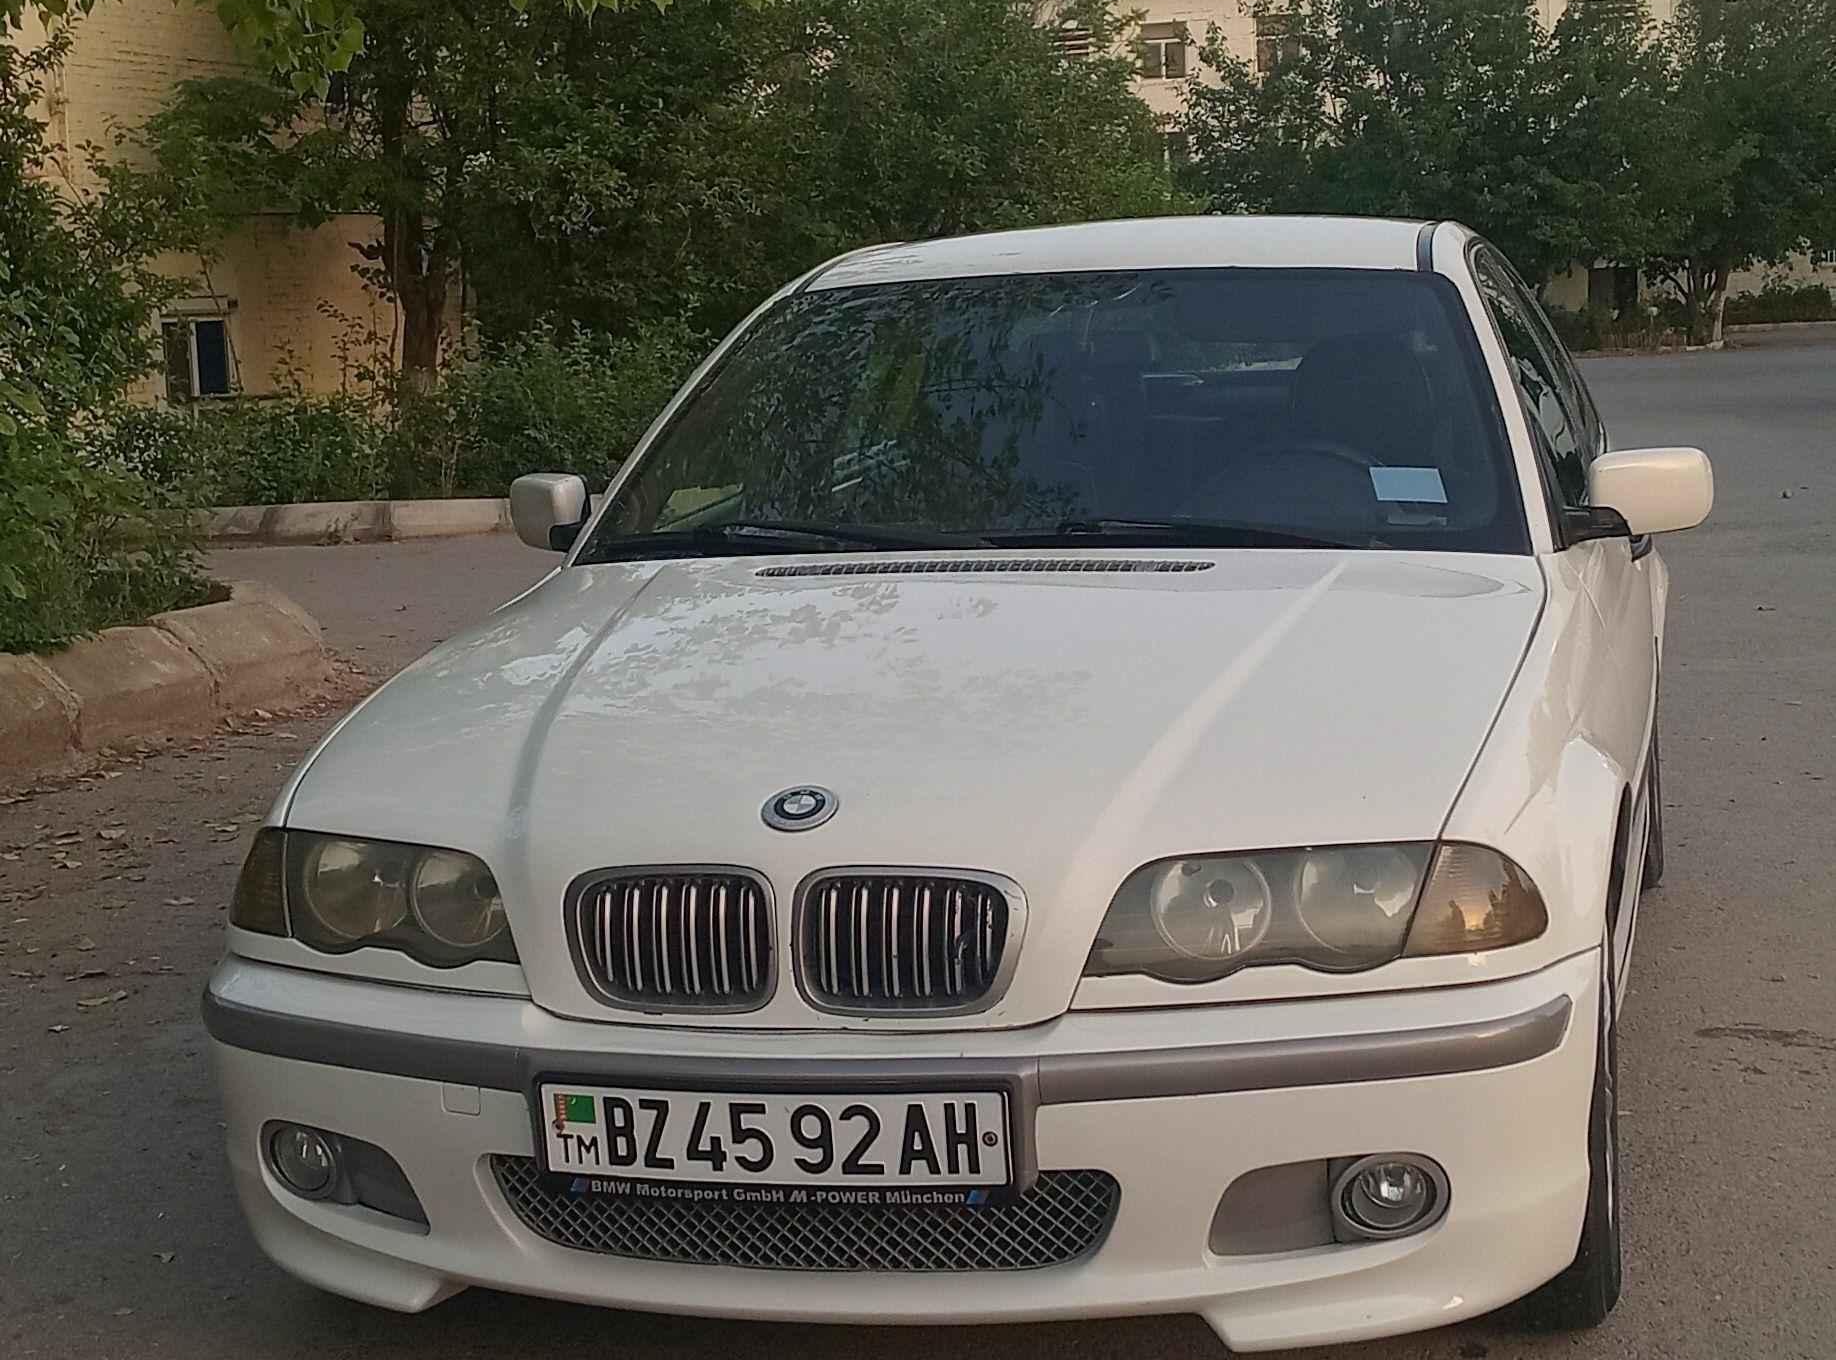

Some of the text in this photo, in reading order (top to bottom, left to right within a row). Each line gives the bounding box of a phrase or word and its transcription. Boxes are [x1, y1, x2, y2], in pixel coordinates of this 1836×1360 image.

[556, 1133, 600, 1165] TM
[602, 1096, 981, 1175] BZ 45 92 AH
[591, 1180, 631, 1194] BMW
[636, 1183, 728, 1201] Motorsport
[733, 1188, 785, 1203] GmbH
